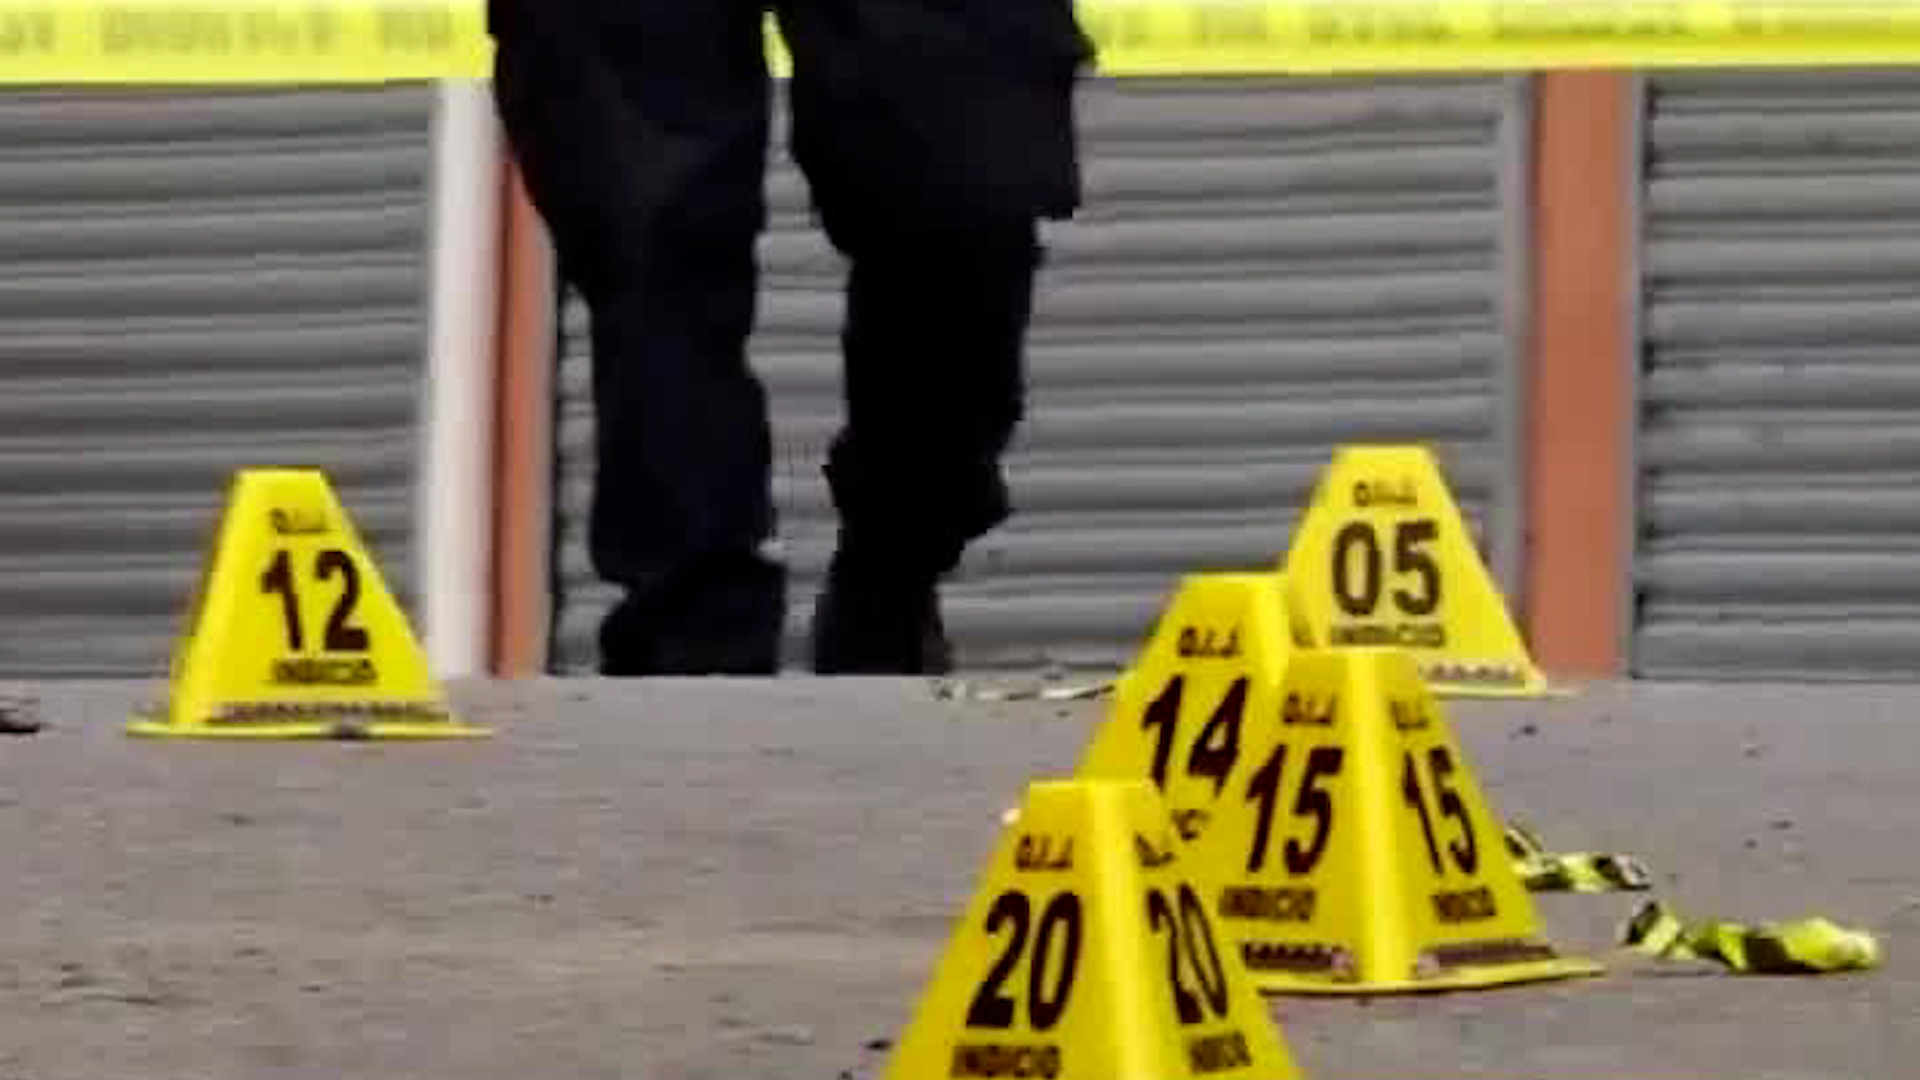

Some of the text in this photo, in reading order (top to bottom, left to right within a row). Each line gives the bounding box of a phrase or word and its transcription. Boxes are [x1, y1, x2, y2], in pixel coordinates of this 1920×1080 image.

[260, 548, 370, 652] 12
[1332, 520, 1439, 616] 05
[1142, 673, 1250, 798] 14
[1245, 743, 1343, 874] 15
[1402, 745, 1478, 876] 15
[966, 890, 1081, 1031] 20
[1146, 883, 1228, 1025] 20
